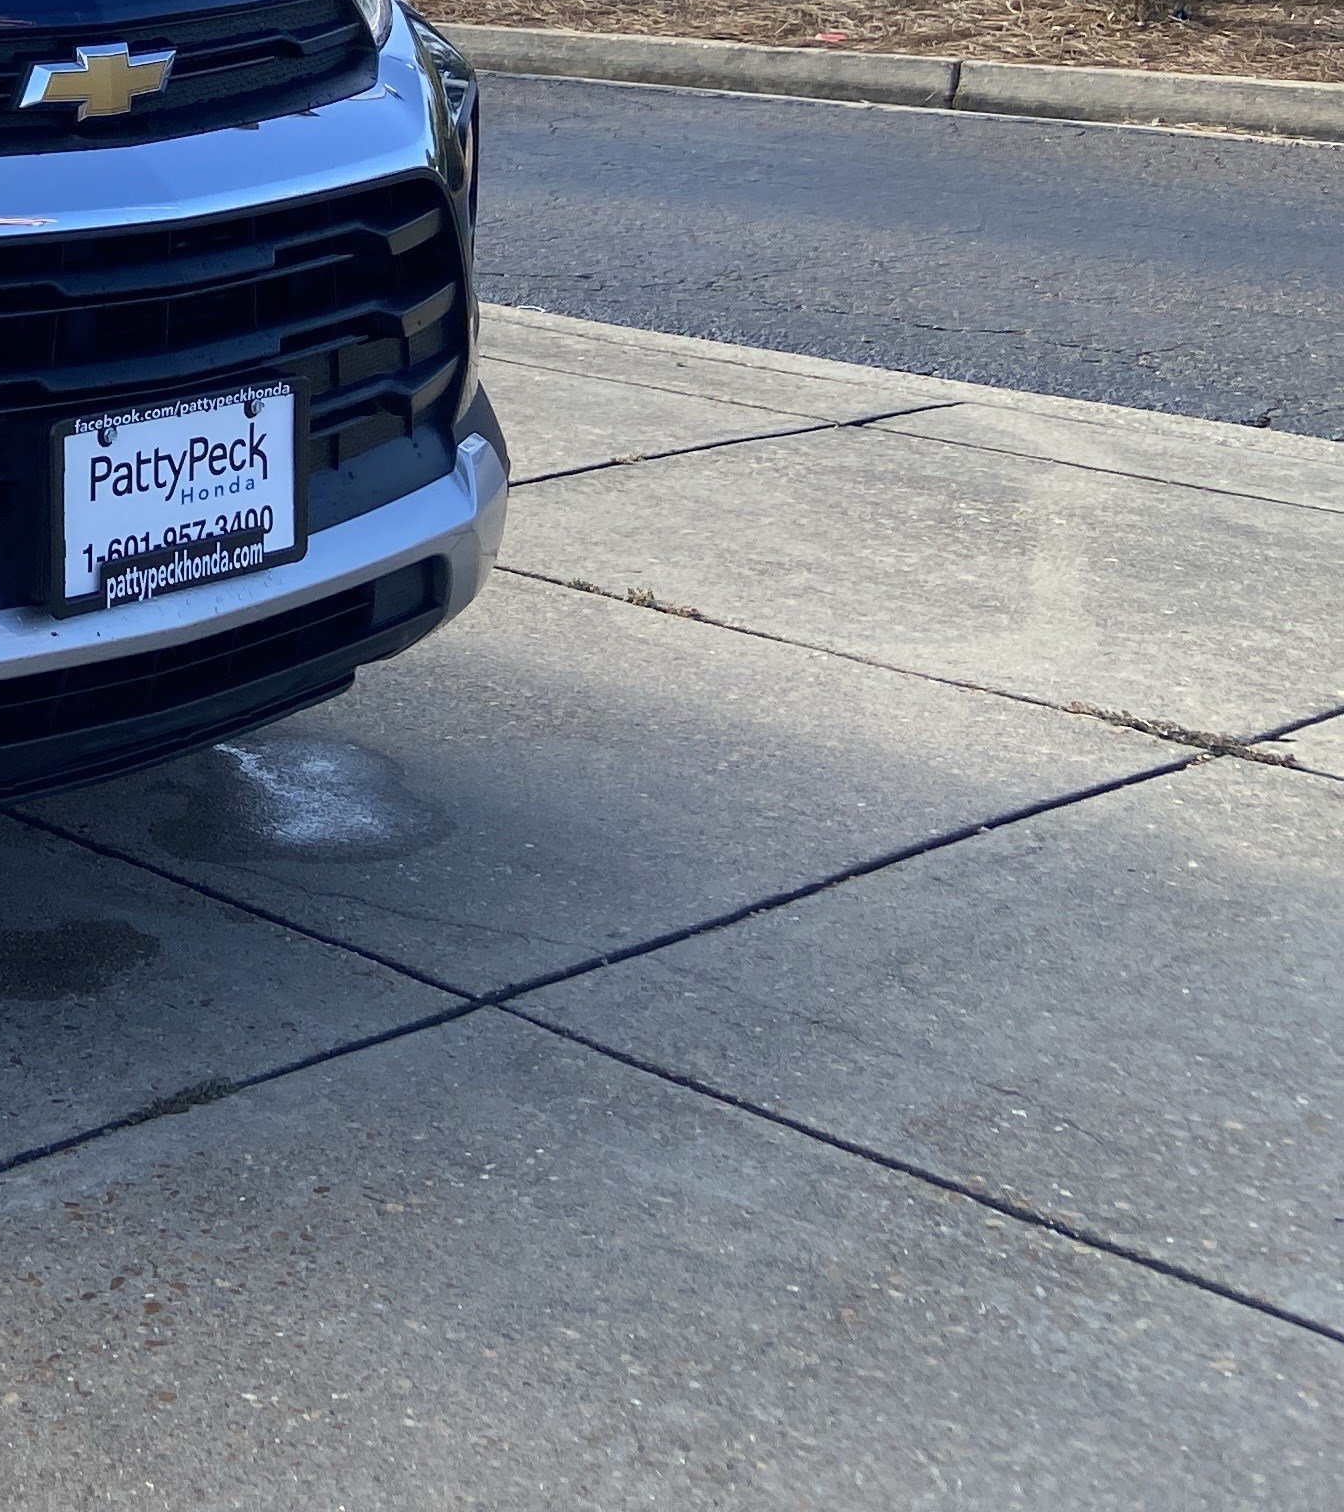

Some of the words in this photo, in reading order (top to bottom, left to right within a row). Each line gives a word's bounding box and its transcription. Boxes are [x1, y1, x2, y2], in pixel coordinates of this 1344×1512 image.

[74, 381, 291, 434] facebook.com/pattypeckhonda
[89, 422, 268, 502] PattyPeck
[180, 475, 256, 505] Honda
[82, 504, 274, 573] 1-601-957-3400
[106, 540, 264, 609] pattypeckhonda.com
